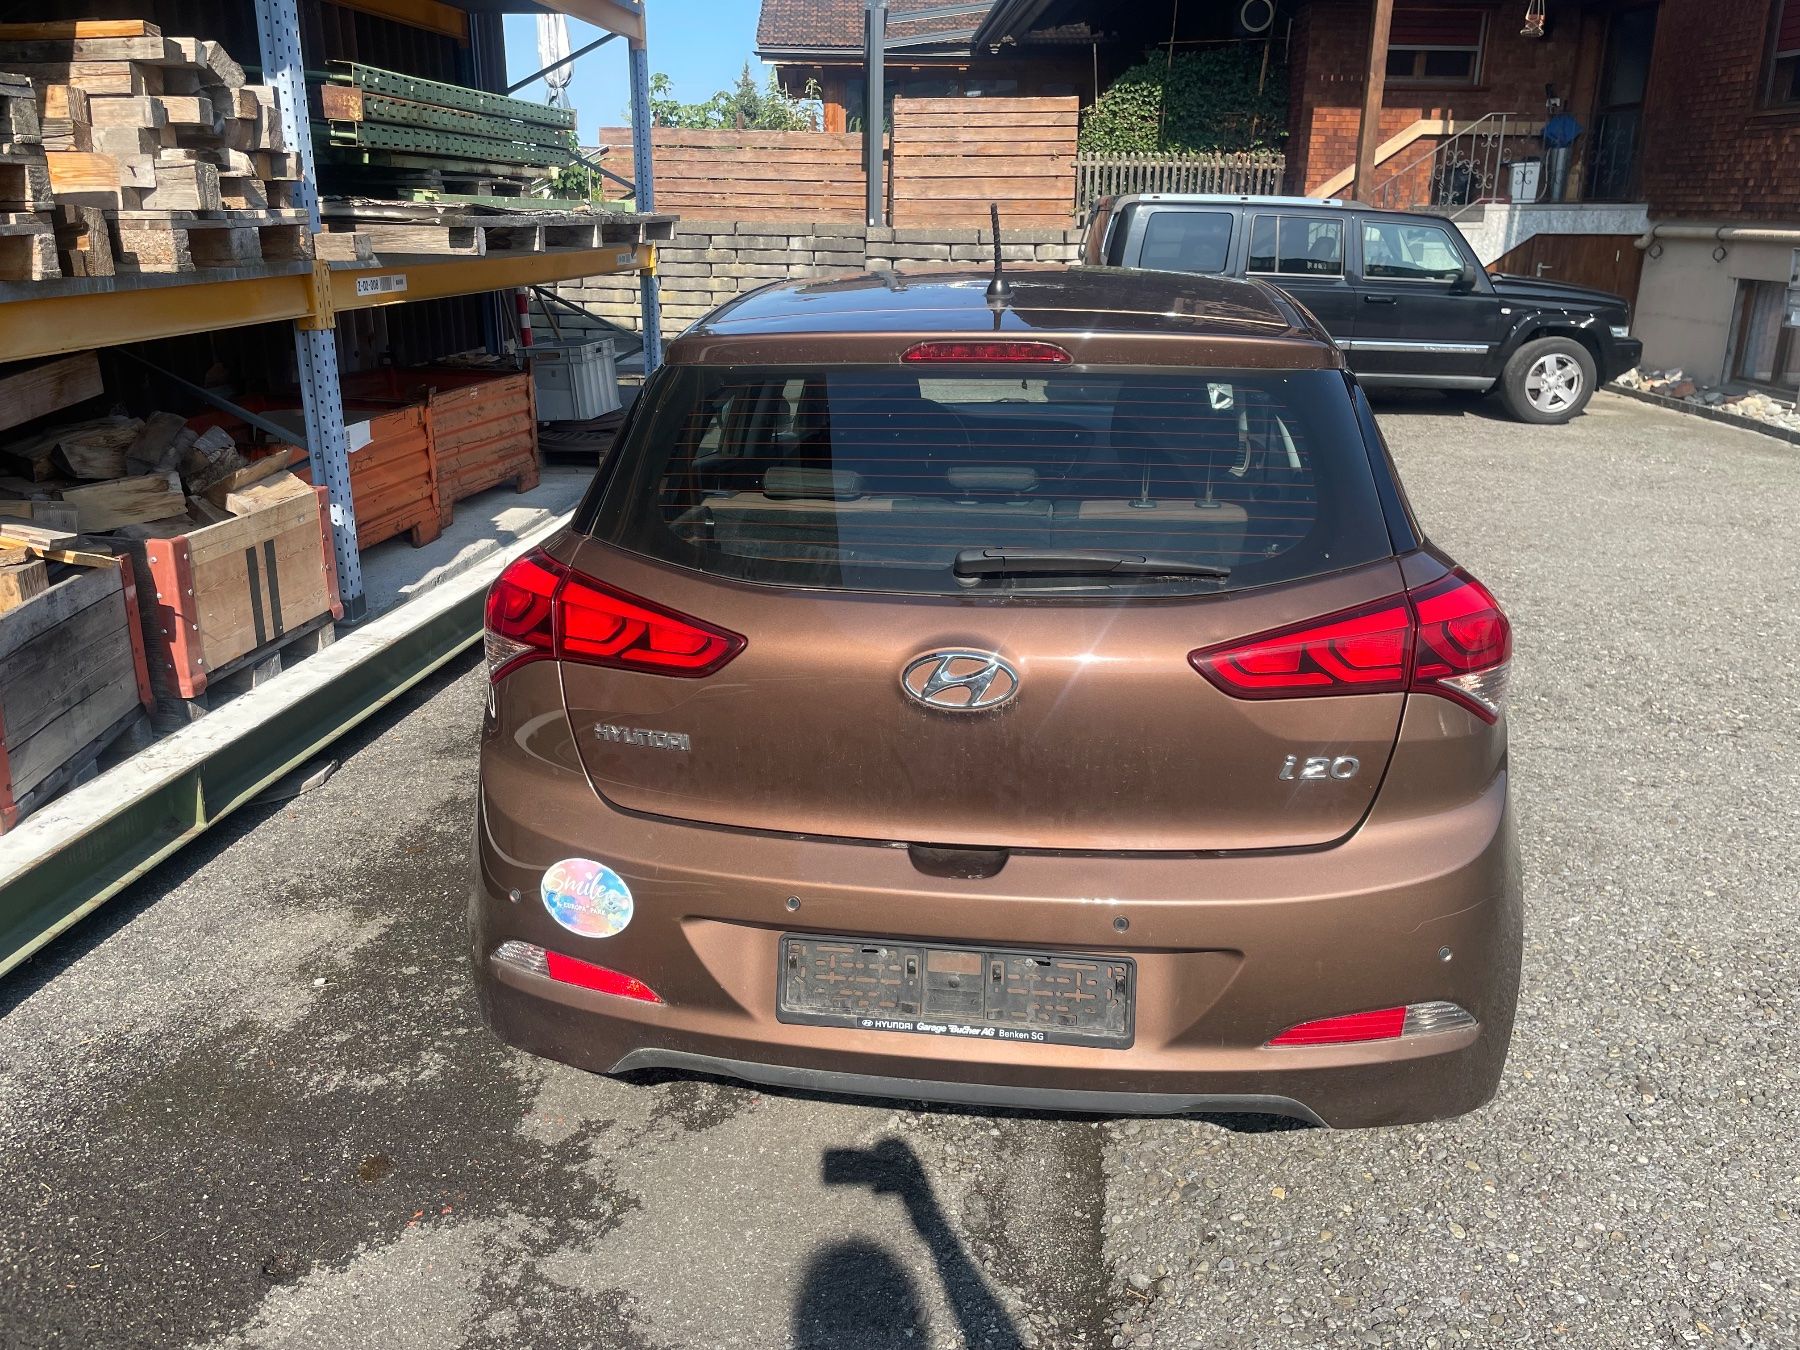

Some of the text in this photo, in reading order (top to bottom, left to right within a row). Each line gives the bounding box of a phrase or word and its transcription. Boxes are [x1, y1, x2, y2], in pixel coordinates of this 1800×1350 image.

[594, 723, 690, 751] HYUNDAI
[1279, 754, 1360, 781] i20
[548, 868, 607, 900] Smile
[875, 1020, 913, 1030] HYUNDAI
[916, 1022, 947, 1034] Garage
[981, 1027, 996, 1037] AG
[999, 1029, 1030, 1040] Benken
[1031, 1031, 1044, 1041] SG
